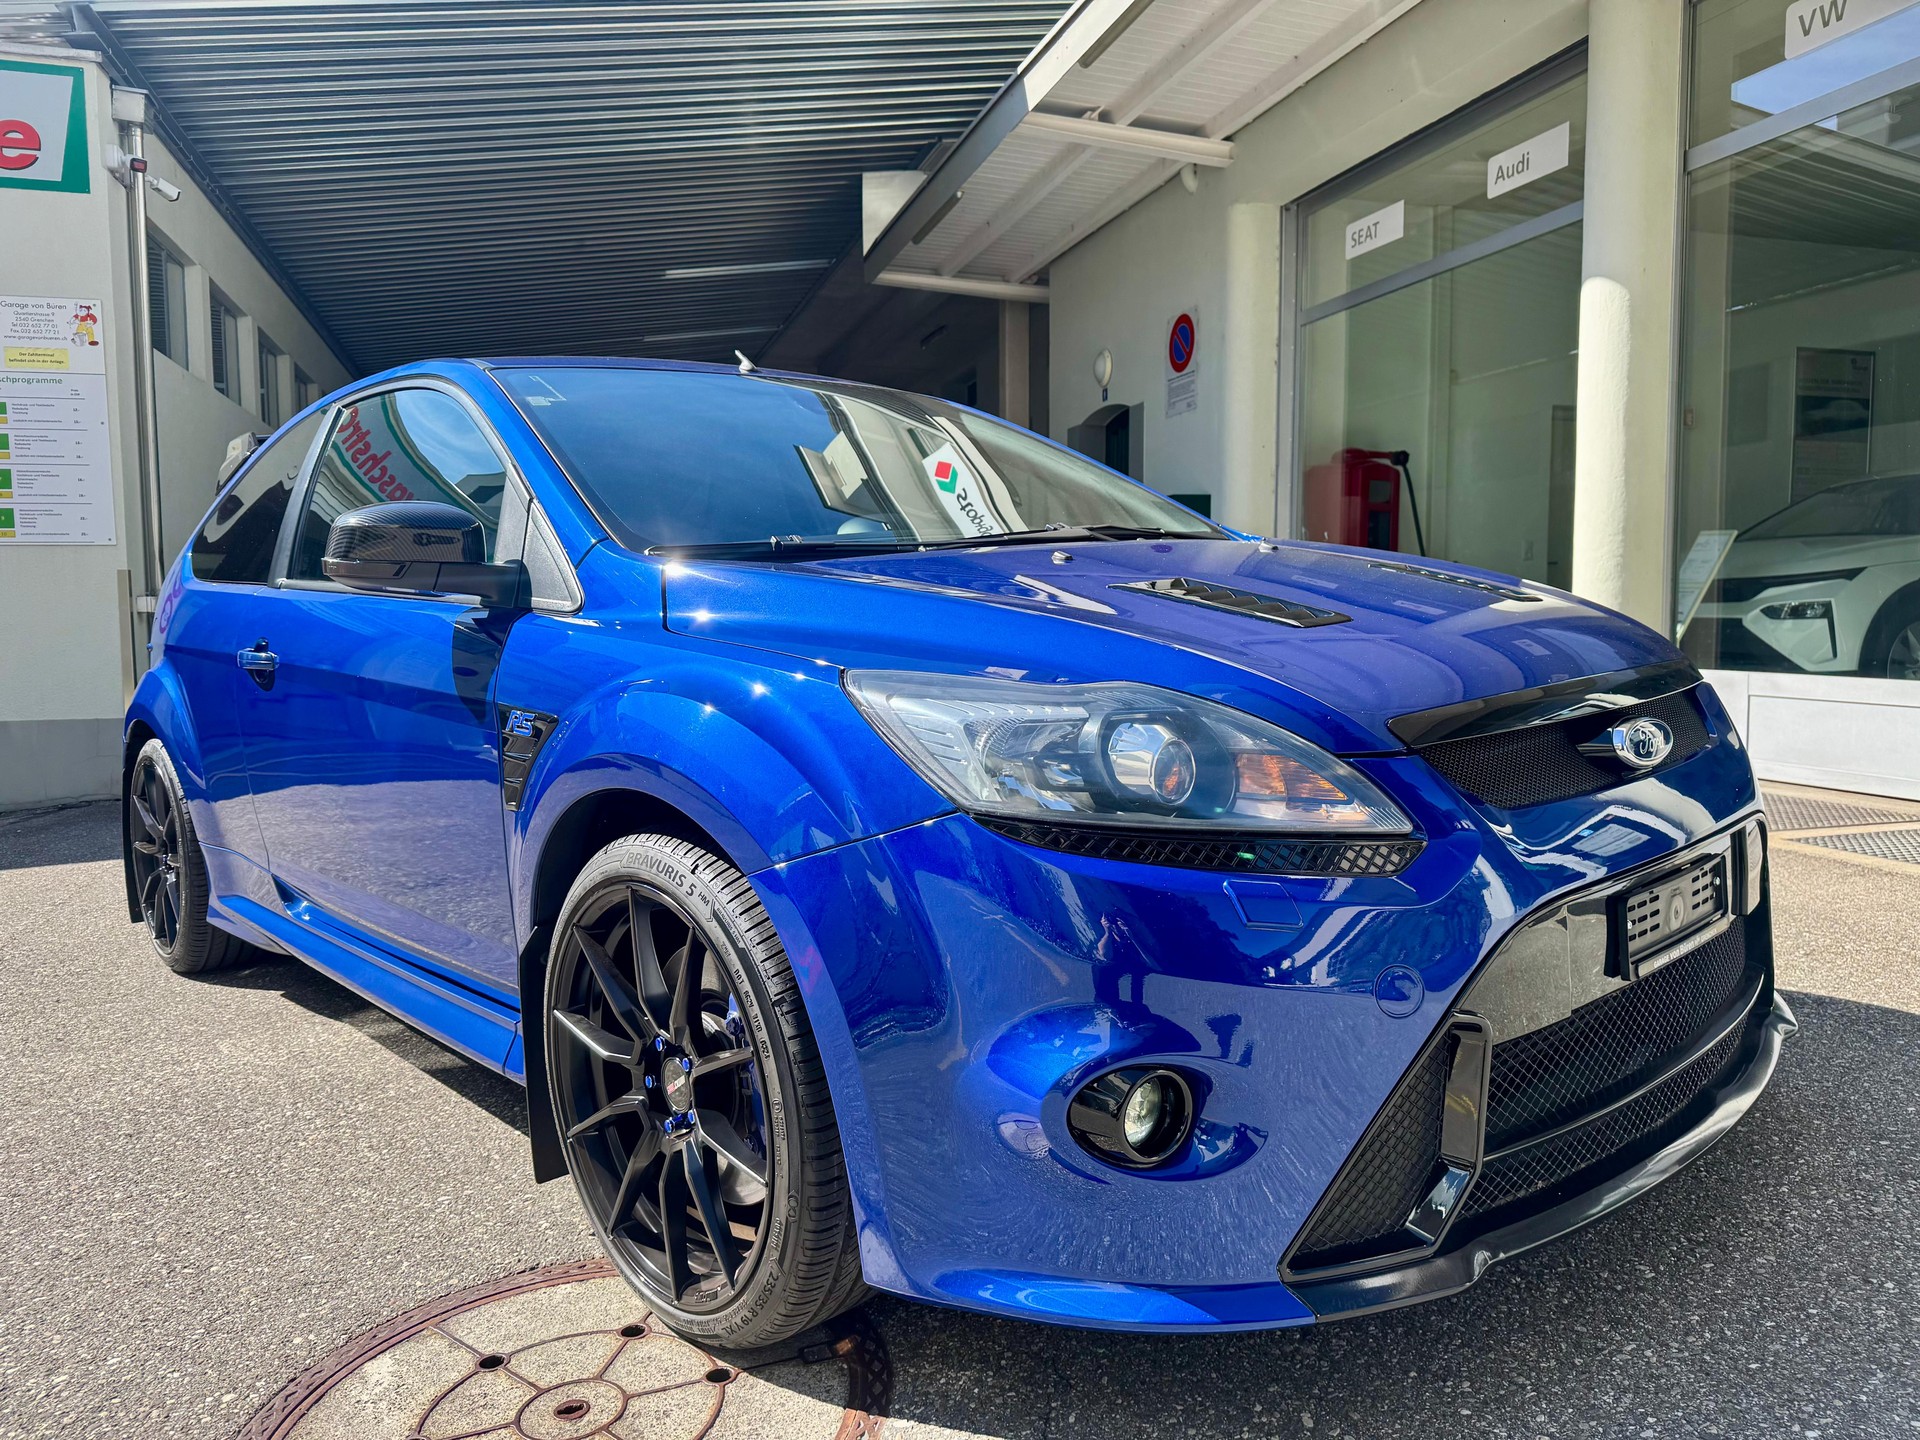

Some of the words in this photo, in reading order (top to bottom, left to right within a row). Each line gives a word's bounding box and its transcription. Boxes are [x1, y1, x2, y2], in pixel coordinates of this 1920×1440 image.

[1798, 0, 1847, 37] VW
[1494, 152, 1530, 185] Audi
[1351, 221, 1380, 248] SEAT
[0, 300, 29, 310] Garage
[46, 302, 67, 310] Büren
[506, 709, 536, 737] RS
[1639, 727, 1665, 756] Ford
[626, 852, 687, 888] BRAVURIS
[754, 1271, 779, 1312] 235/35
[740, 1315, 753, 1326] 19
[748, 1308, 759, 1322] R
[721, 1324, 738, 1338] XL
